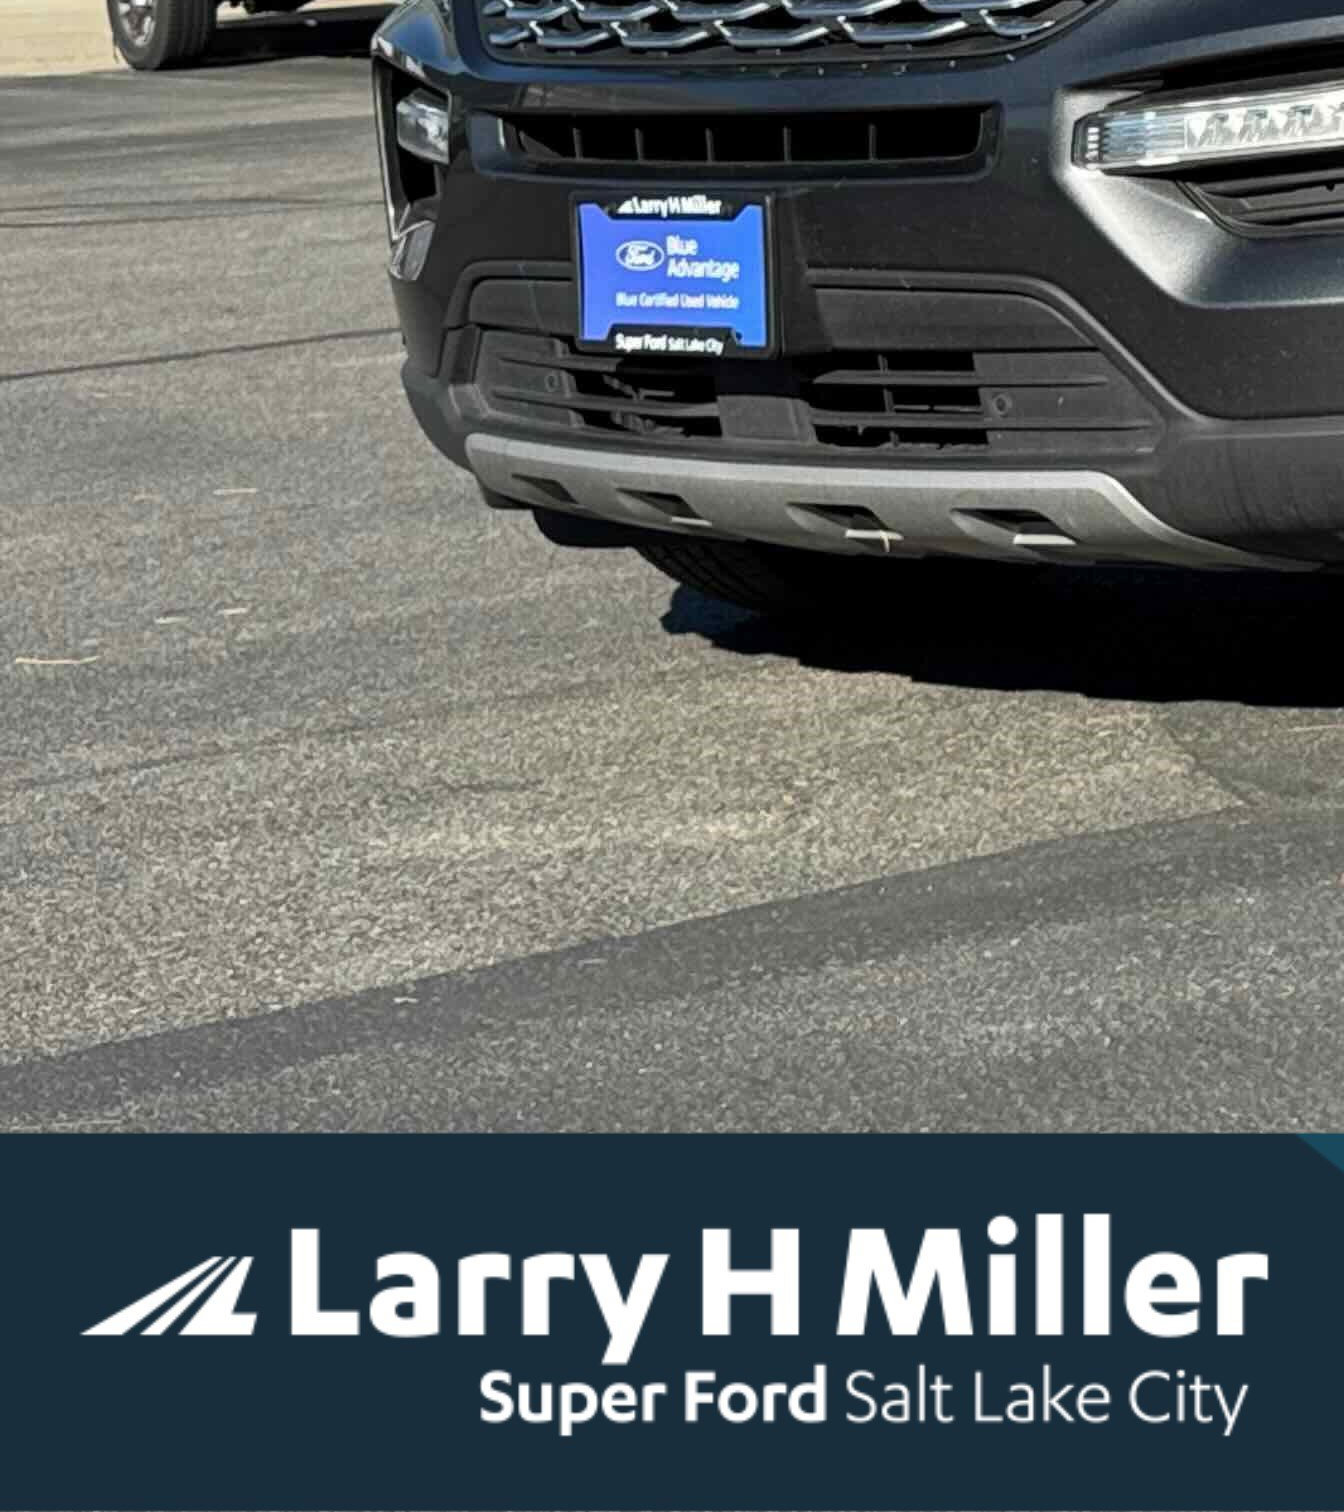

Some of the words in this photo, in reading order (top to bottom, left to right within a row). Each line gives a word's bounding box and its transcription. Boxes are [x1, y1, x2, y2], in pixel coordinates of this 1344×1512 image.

[632, 195, 668, 218] Larry
[668, 196, 681, 215] H
[681, 194, 722, 215] Miller
[625, 244, 656, 265] Ford
[666, 235, 698, 256] Blue
[666, 258, 740, 283] Advantage
[615, 292, 638, 307] Blue
[639, 292, 679, 308] Certified
[680, 293, 705, 308] Used
[705, 293, 739, 308] Vehicle
[616, 332, 643, 352] Super
[644, 334, 667, 351] Ford
[705, 337, 724, 356] City
